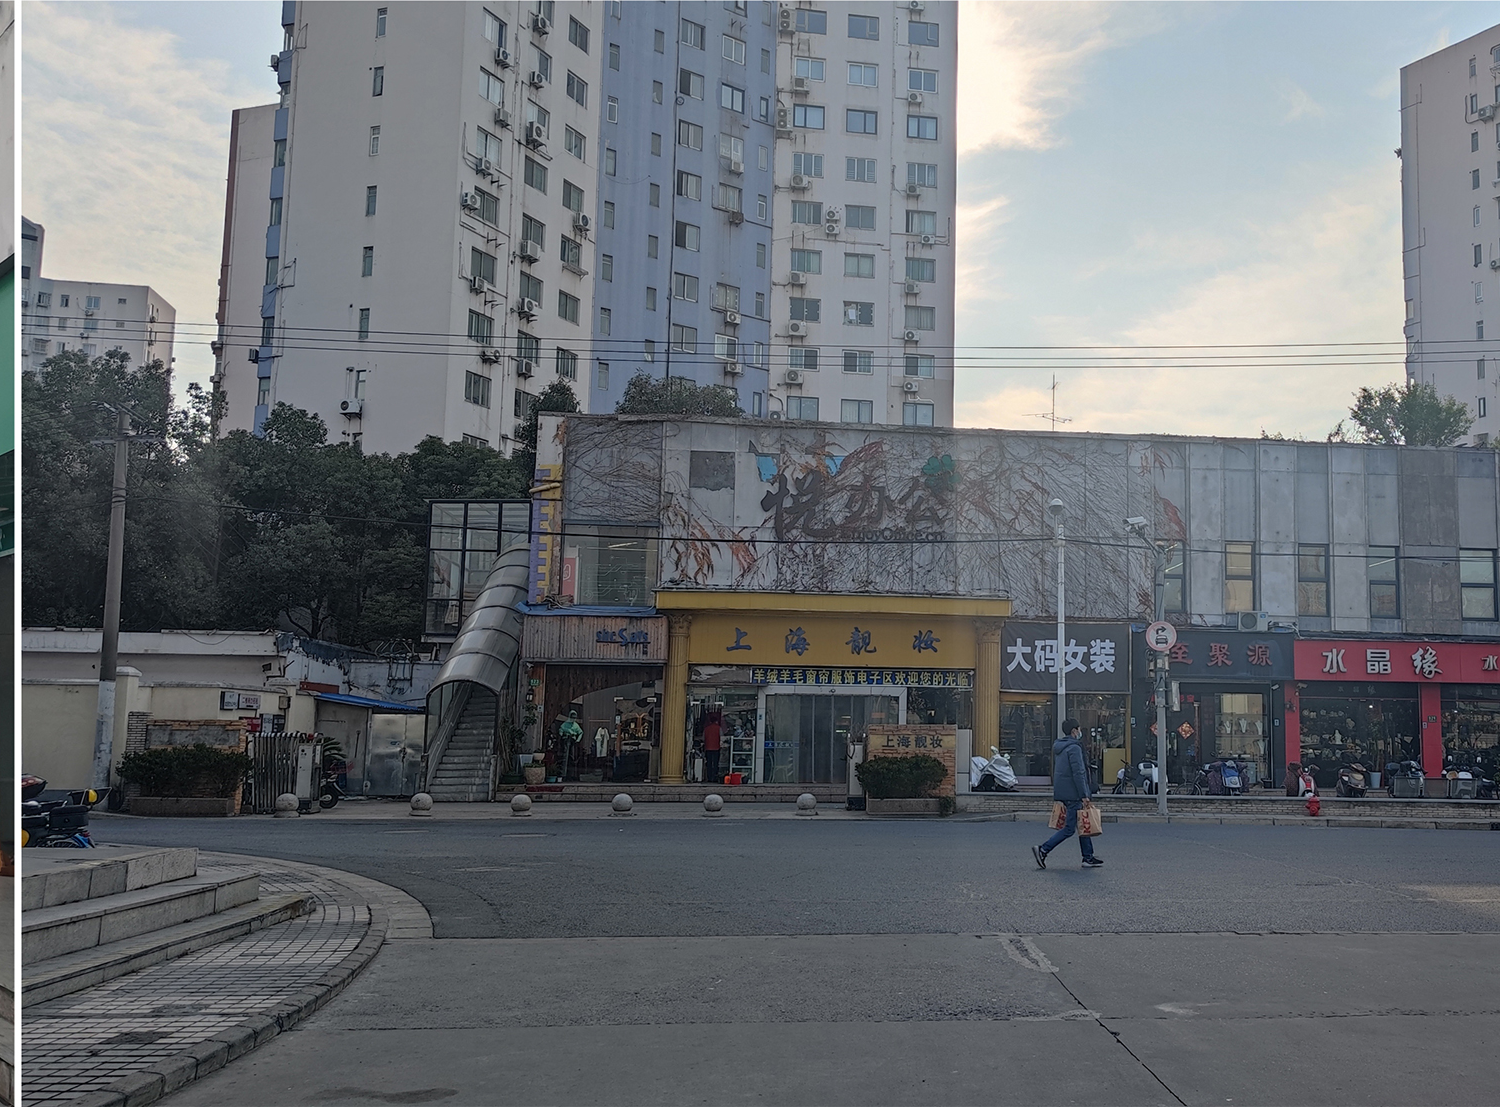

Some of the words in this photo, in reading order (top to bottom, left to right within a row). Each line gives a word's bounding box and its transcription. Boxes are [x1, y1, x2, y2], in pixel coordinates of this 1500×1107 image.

[726, 626, 941, 656] 上海靓妆
[1006, 638, 1116, 674] 大码女装
[1168, 642, 1274, 667] 至聚源
[1322, 646, 1443, 679] 水晶缘
[754, 668, 969, 686] 羊绒羊毛窗帘服饰电子区欢迎您的光临
[882, 735, 943, 749] 上海靓妆
[1081, 811, 1091, 834] KFC
